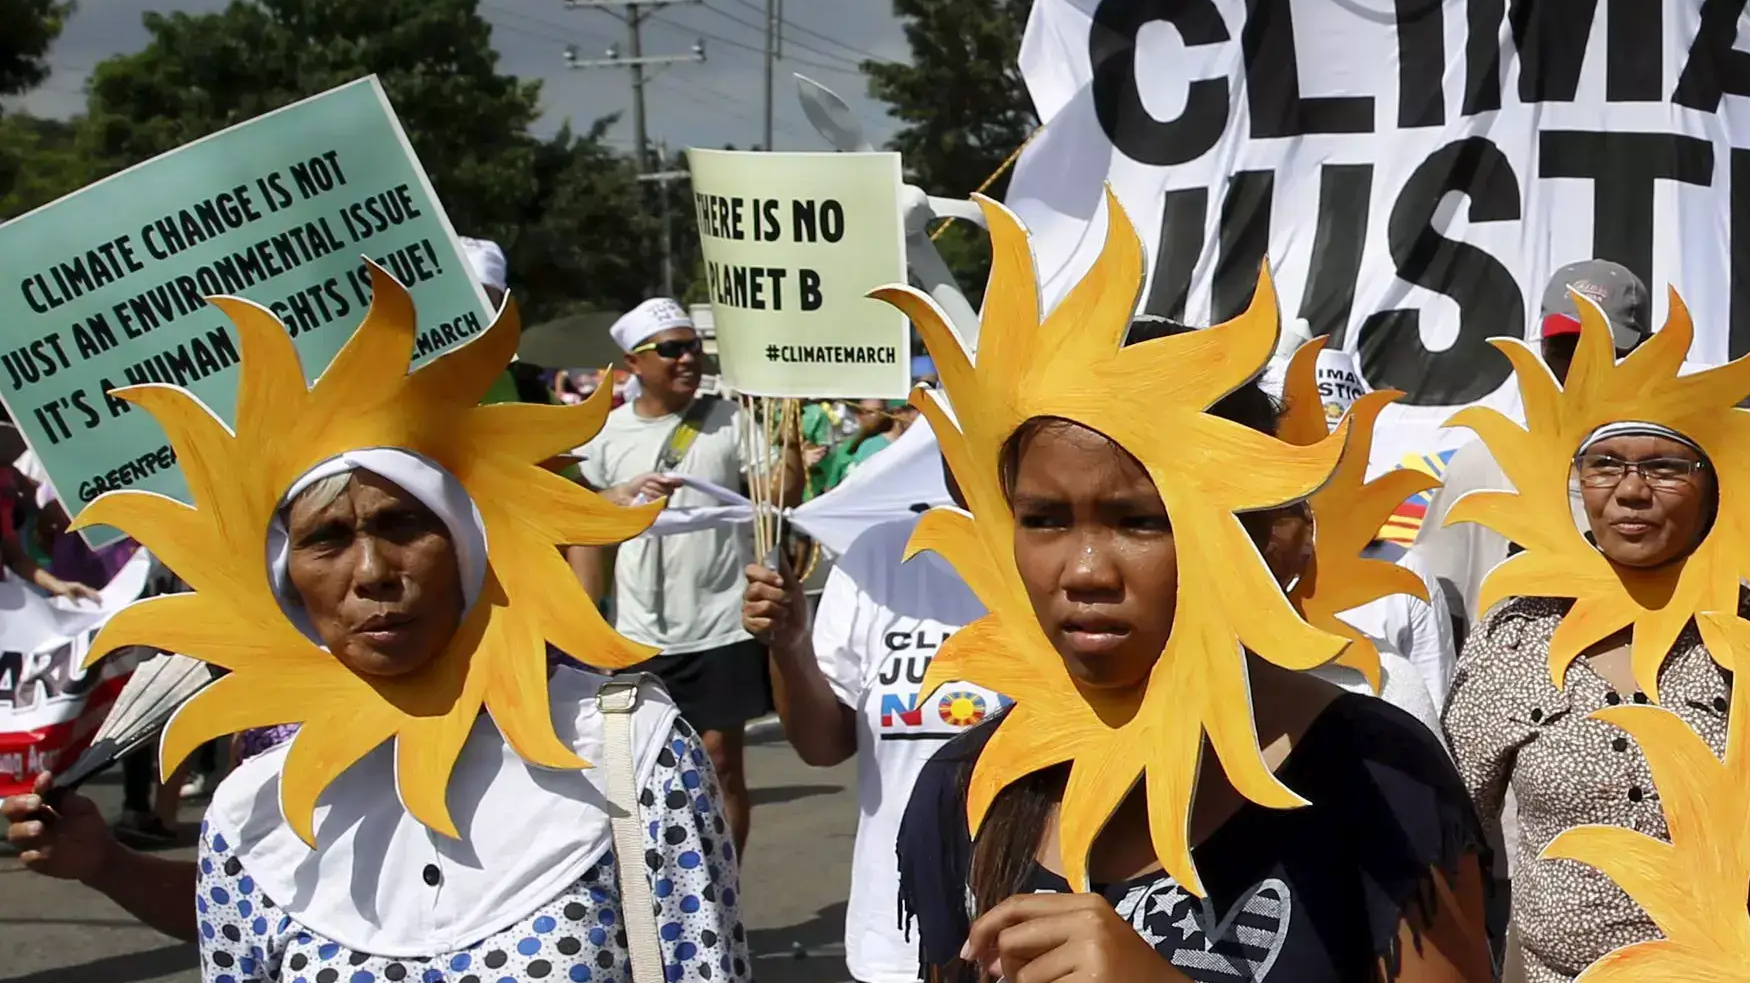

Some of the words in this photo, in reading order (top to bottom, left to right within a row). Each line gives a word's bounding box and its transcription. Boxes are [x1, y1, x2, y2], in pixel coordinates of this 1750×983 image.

[20, 235, 144, 314] CLIMATE
[140, 185, 261, 260] CHANGE
[257, 172, 292, 212] IS
[295, 150, 347, 200] NOT
[696, 193, 744, 240] THERE
[753, 199, 781, 242] IS
[792, 199, 845, 243] NO
[1, 332, 72, 390] JUST
[72, 313, 118, 360] AN
[119, 216, 344, 340] ENVIRONMENTAL
[339, 184, 420, 242] ISSUE
[708, 260, 786, 311] PLANET
[800, 269, 823, 311] B
[33, 389, 100, 445] IT'S
[100, 378, 131, 417] A
[269, 277, 350, 338] GHTS
[765, 344, 896, 364] #CLIMATEMARCH
